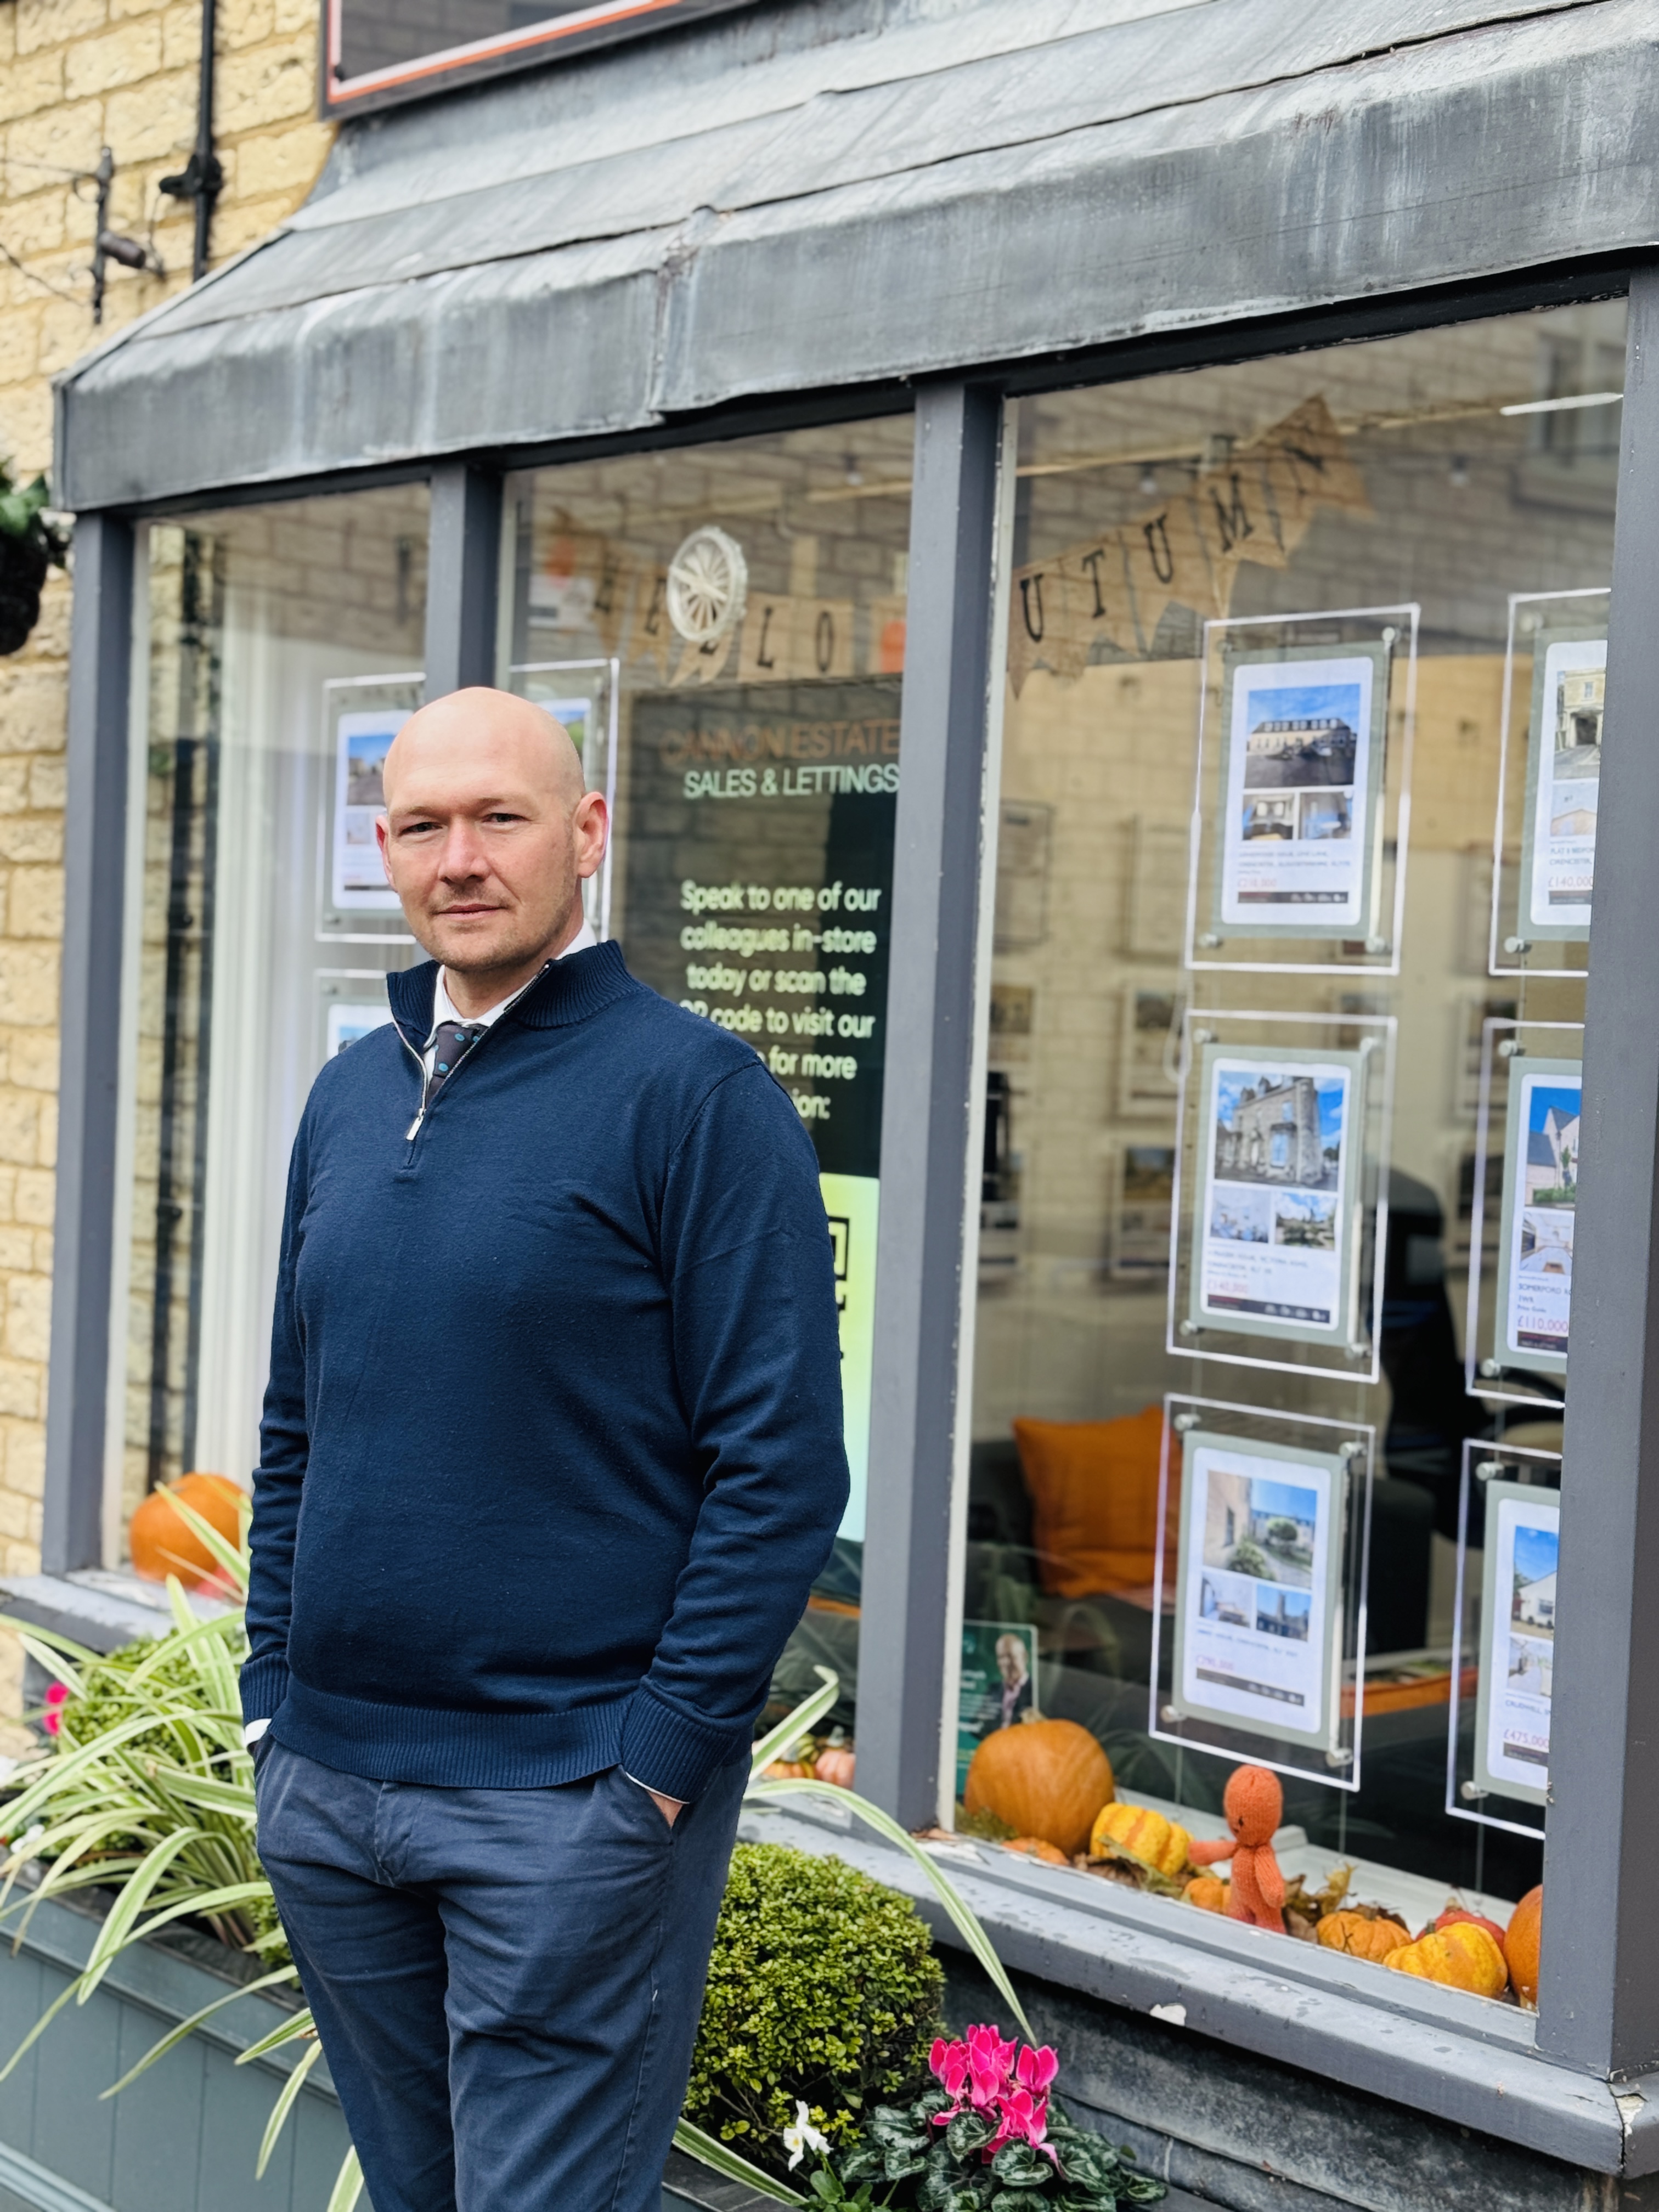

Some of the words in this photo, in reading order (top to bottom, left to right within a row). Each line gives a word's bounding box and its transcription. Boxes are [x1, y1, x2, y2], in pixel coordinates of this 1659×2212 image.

[789, 719, 900, 759] ESTATE
[684, 769, 757, 799] SALES
[760, 768, 778, 796] &
[783, 763, 900, 795] LETTINGS
[681, 879, 744, 915] Speak
[747, 884, 770, 910] to
[773, 887, 815, 911] one
[817, 882, 843, 911] of
[844, 887, 881, 911] our
[680, 921, 789, 957] colleagues
[793, 923, 876, 953] in-store
[686, 962, 747, 996] today
[749, 969, 772, 992] or
[775, 970, 825, 993] scan
[829, 966, 866, 996] the
[710, 1003, 763, 1032] code
[766, 1006, 789, 1034] to
[792, 1006, 834, 1036] visit
[838, 1014, 876, 1038] our
[768, 1045, 799, 1075] for
[802, 1054, 857, 1079] more
[1517, 1314, 1568, 1333] £110,000
